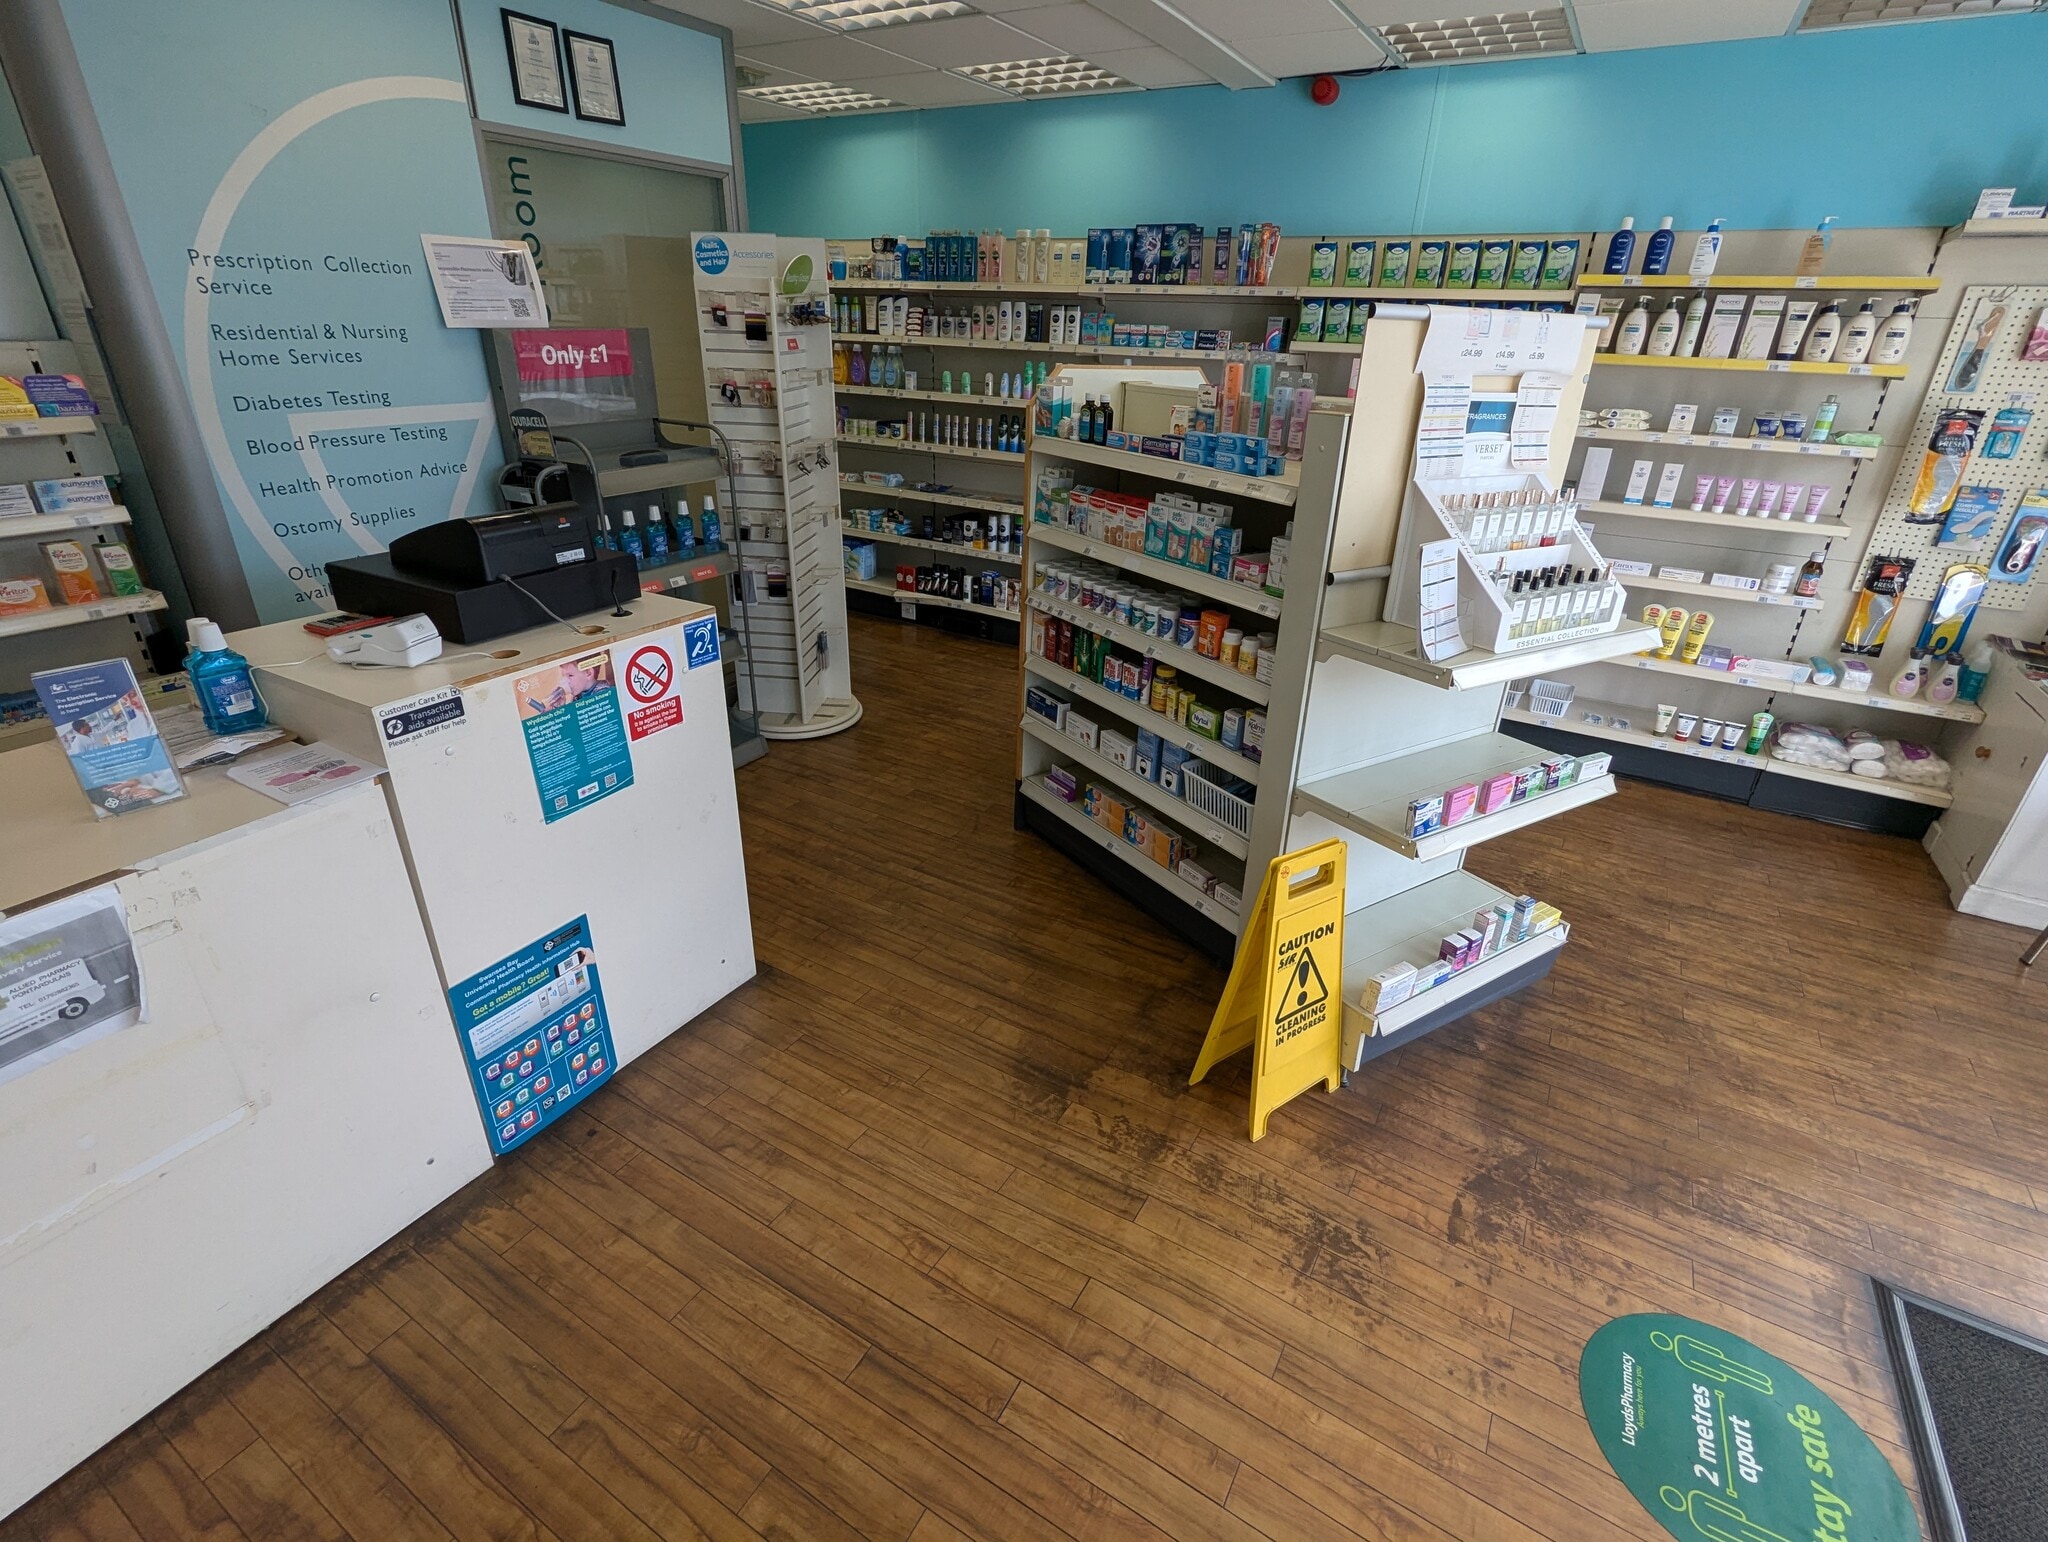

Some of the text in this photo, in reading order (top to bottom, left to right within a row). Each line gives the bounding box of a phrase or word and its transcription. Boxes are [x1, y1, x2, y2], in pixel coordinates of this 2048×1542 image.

[187, 249, 313, 274] Prescription
[324, 255, 412, 276] Collection
[695, 250, 728, 258] Cosmetics
[700, 258, 726, 266] and Hair
[732, 250, 774, 259] Accessories
[196, 276, 273, 296] Service
[211, 324, 408, 343] Residential & Nursing
[219, 349, 363, 367] Home Services
[542, 344, 608, 369] Only £1
[1496, 351, 1515, 359] £14.99
[1529, 352, 1544, 360] £5.99
[233, 390, 392, 412] Diabetes Testing
[512, 415, 548, 428] DURACELL
[246, 426, 448, 456] Blood Pressure Testing
[1144, 439, 1170, 450] Germolene
[1475, 444, 1504, 454] VERSET
[60, 479, 104, 488] eumovate
[259, 461, 468, 498] Health Promotion Advice
[67, 494, 110, 504] eumovate
[272, 506, 416, 539] Ostomy Supplies
[1438, 508, 1488, 582] TRY THEM NOW
[1613, 560, 1634, 570] Eurax
[1516, 626, 1600, 649] ESSENTIAL COLLECTION
[707, 644, 713, 652] T
[57, 694, 116, 710] Prescription Service
[66, 692, 98, 702] Electronic
[379, 691, 448, 717] Customer Care Kit
[575, 690, 612, 708] Did you know?
[408, 702, 456, 720] Transaction
[526, 708, 566, 726] Wyddoch chi?
[577, 704, 598, 715] Improving
[578, 714, 588, 722] lung
[588, 708, 602, 718] health
[633, 699, 676, 720] No smoking
[408, 708, 461, 731] aids available
[579, 718, 588, 727] help
[580, 717, 608, 730] environment
[643, 722, 659, 731] smoke
[664, 714, 677, 723] these
[644, 714, 661, 724] against
[1194, 713, 1209, 726] Nytol
[1248, 720, 1265, 734] Kalms
[388, 718, 467, 748] Please ask staff for help
[646, 722, 669, 735] premises
[1278, 922, 1335, 956] CAUTION
[26, 950, 62, 968] Service
[1277, 952, 1298, 970] SIR
[9, 960, 80, 995] ALLIED PHARMACY
[464, 955, 535, 998] University Health Board
[465, 988, 498, 1009] Community
[498, 972, 524, 991] Pharmacy
[525, 962, 542, 975] Health
[542, 946, 570, 964] Information
[570, 940, 580, 948] Hub
[479, 958, 519, 983] Swansea Bay
[12, 972, 72, 1000] PONTARDULAIS
[472, 1004, 488, 1018] Got
[495, 982, 526, 1003] mobile?
[527, 967, 550, 984] Great!
[1276, 1002, 1327, 1036] CLEANING
[1275, 1013, 1326, 1048] IN PROGRESS
[1636, 1366, 1644, 1378] you
[1620, 1351, 1638, 1446] LloydsPharmacy
[1636, 1388, 1645, 1402] here
[1636, 1404, 1646, 1429] Always
[1691, 1382, 1720, 1487] 2 metres
[1728, 1414, 1764, 1484] apart
[1786, 1404, 1852, 1542] tay safe
